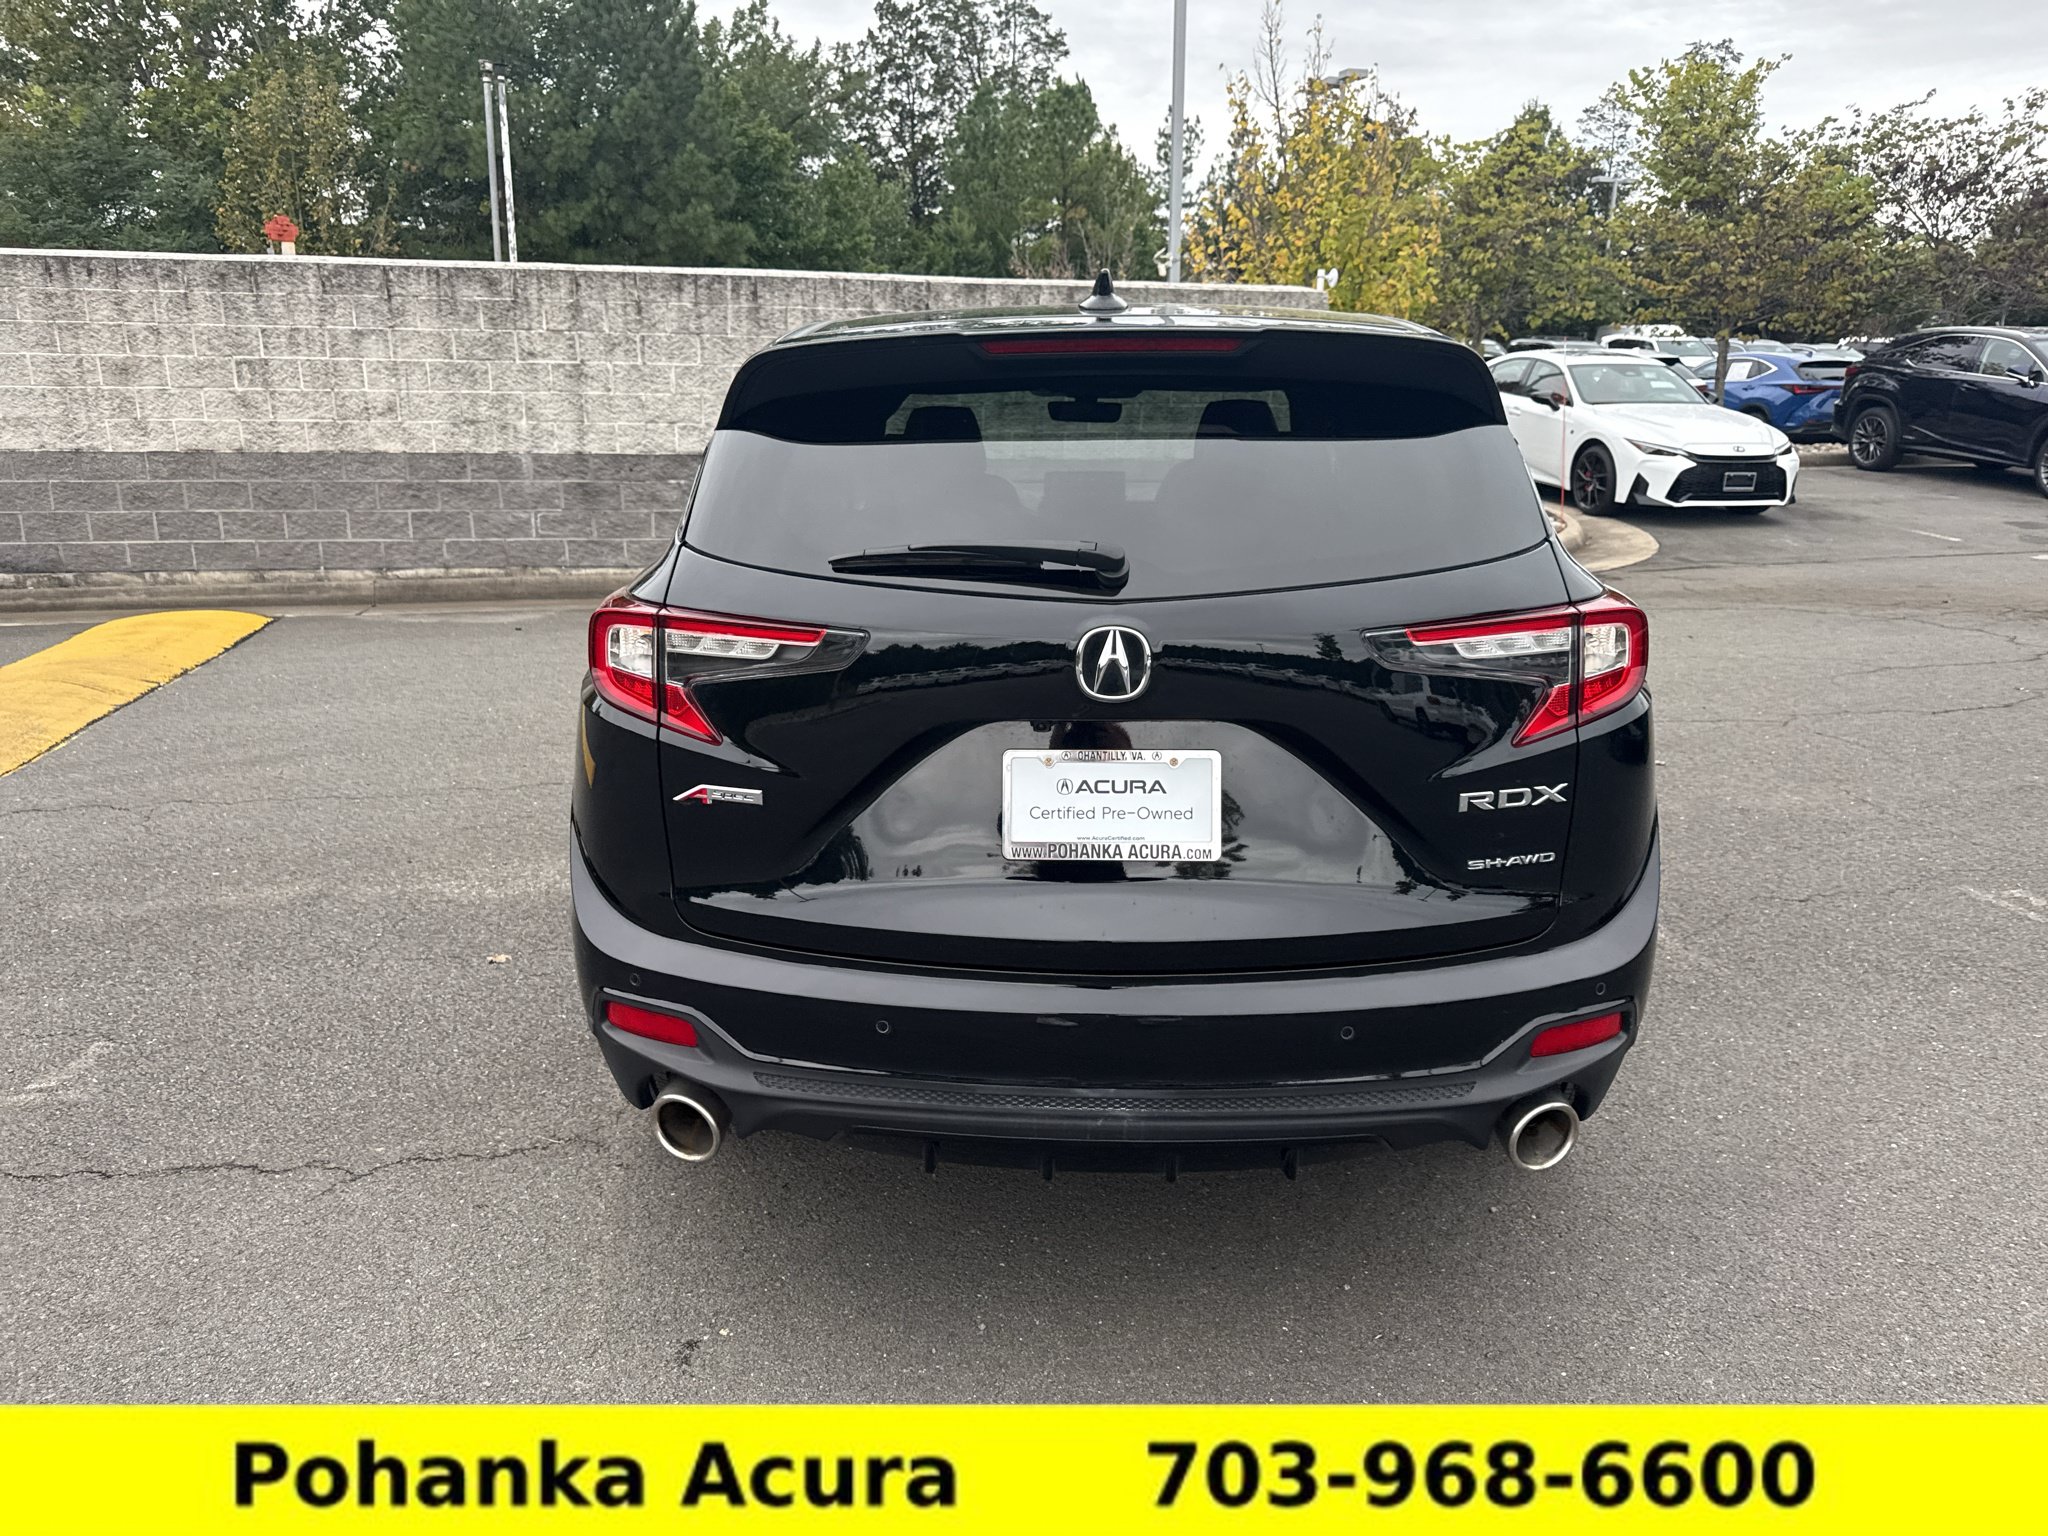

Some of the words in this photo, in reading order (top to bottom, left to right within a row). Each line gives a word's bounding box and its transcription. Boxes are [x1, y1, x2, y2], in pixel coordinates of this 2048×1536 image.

[1131, 751, 1146, 761] VA.
[1075, 779, 1167, 794] ACURA
[1458, 783, 1568, 812] RDX
[1029, 806, 1096, 820] Certified
[1102, 806, 1193, 820] Pre-Owned
[1467, 852, 1556, 870] SH-AWD
